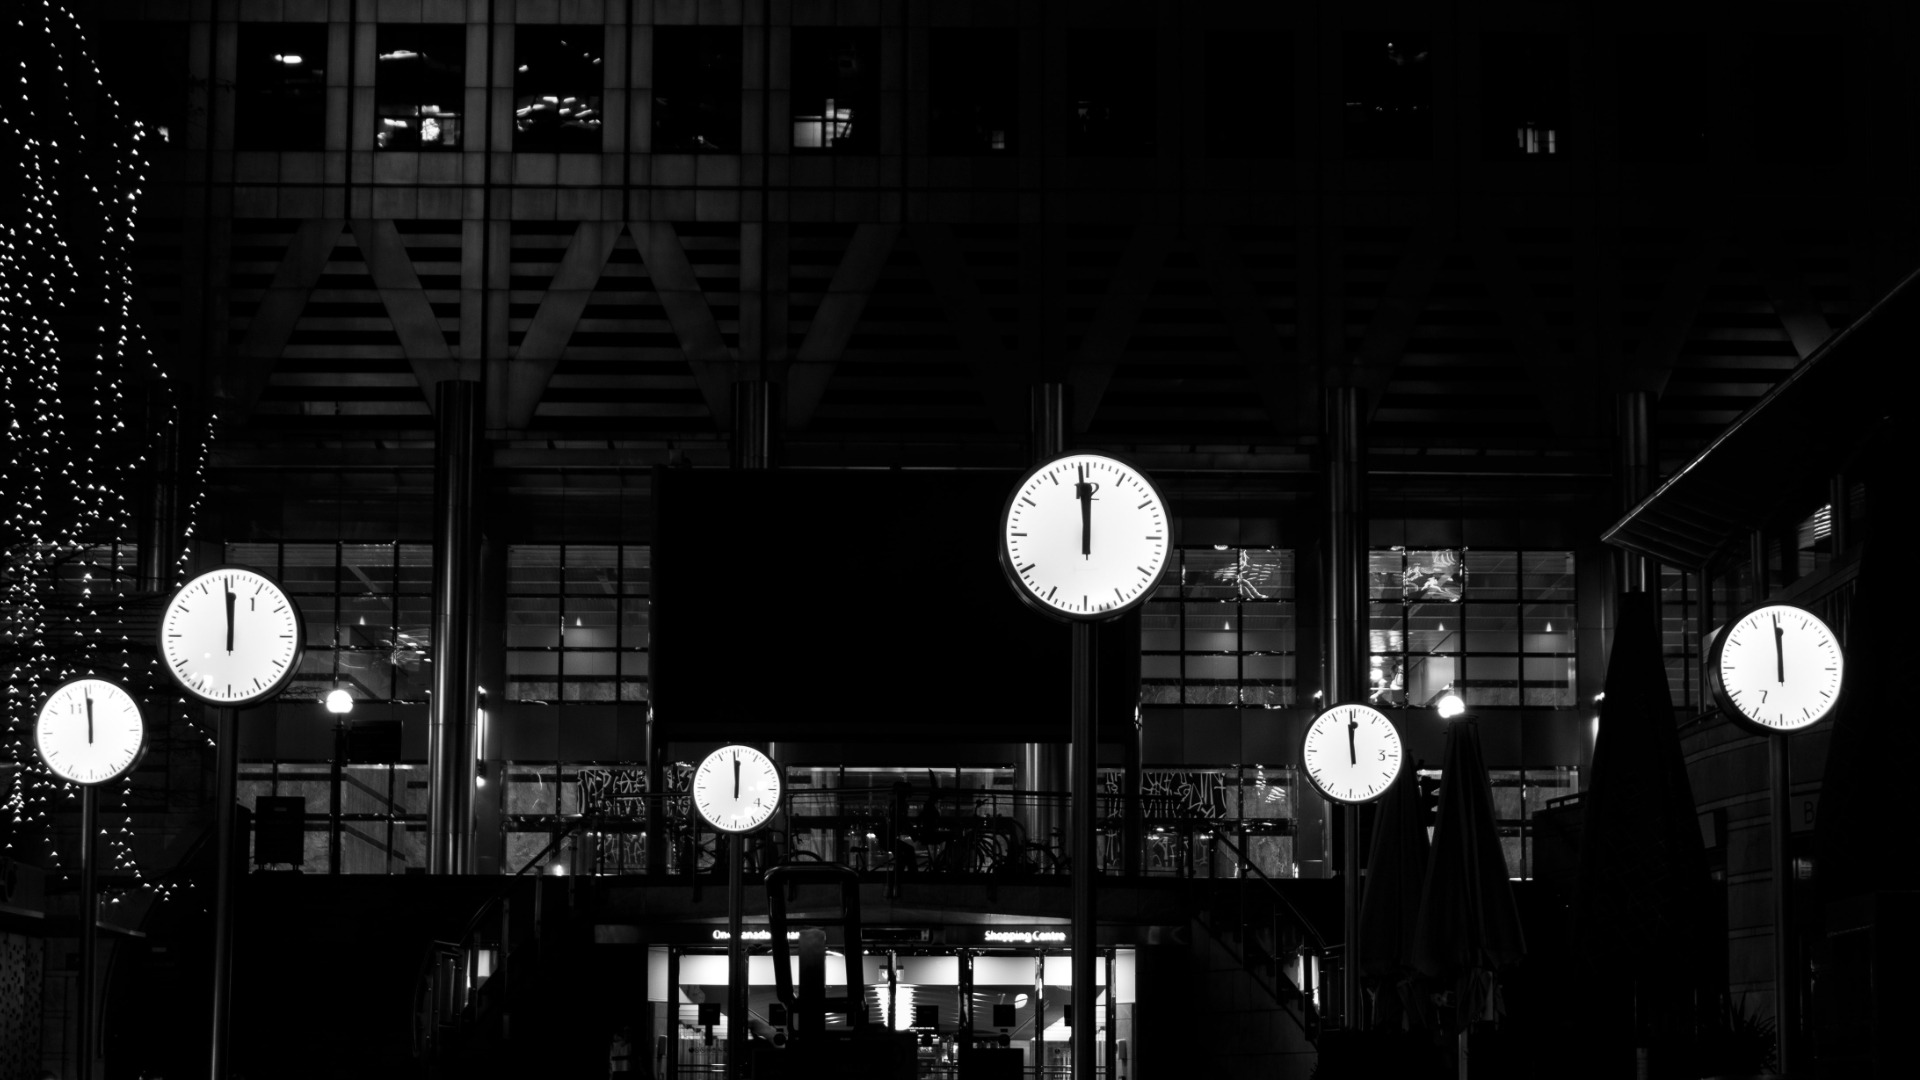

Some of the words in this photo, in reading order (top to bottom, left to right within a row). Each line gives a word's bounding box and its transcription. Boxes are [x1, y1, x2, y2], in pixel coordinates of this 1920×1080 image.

[1074, 482, 1100, 501] 12
[250, 597, 255, 611] 1
[1759, 690, 1768, 704] 7
[70, 703, 82, 715] 11
[1378, 749, 1386, 761] 3
[753, 797, 761, 807] 4
[1804, 801, 1815, 824] B
[740, 929, 771, 940] anada
[984, 930, 1032, 943] Shopping
[1032, 930, 1066, 942] Centre
